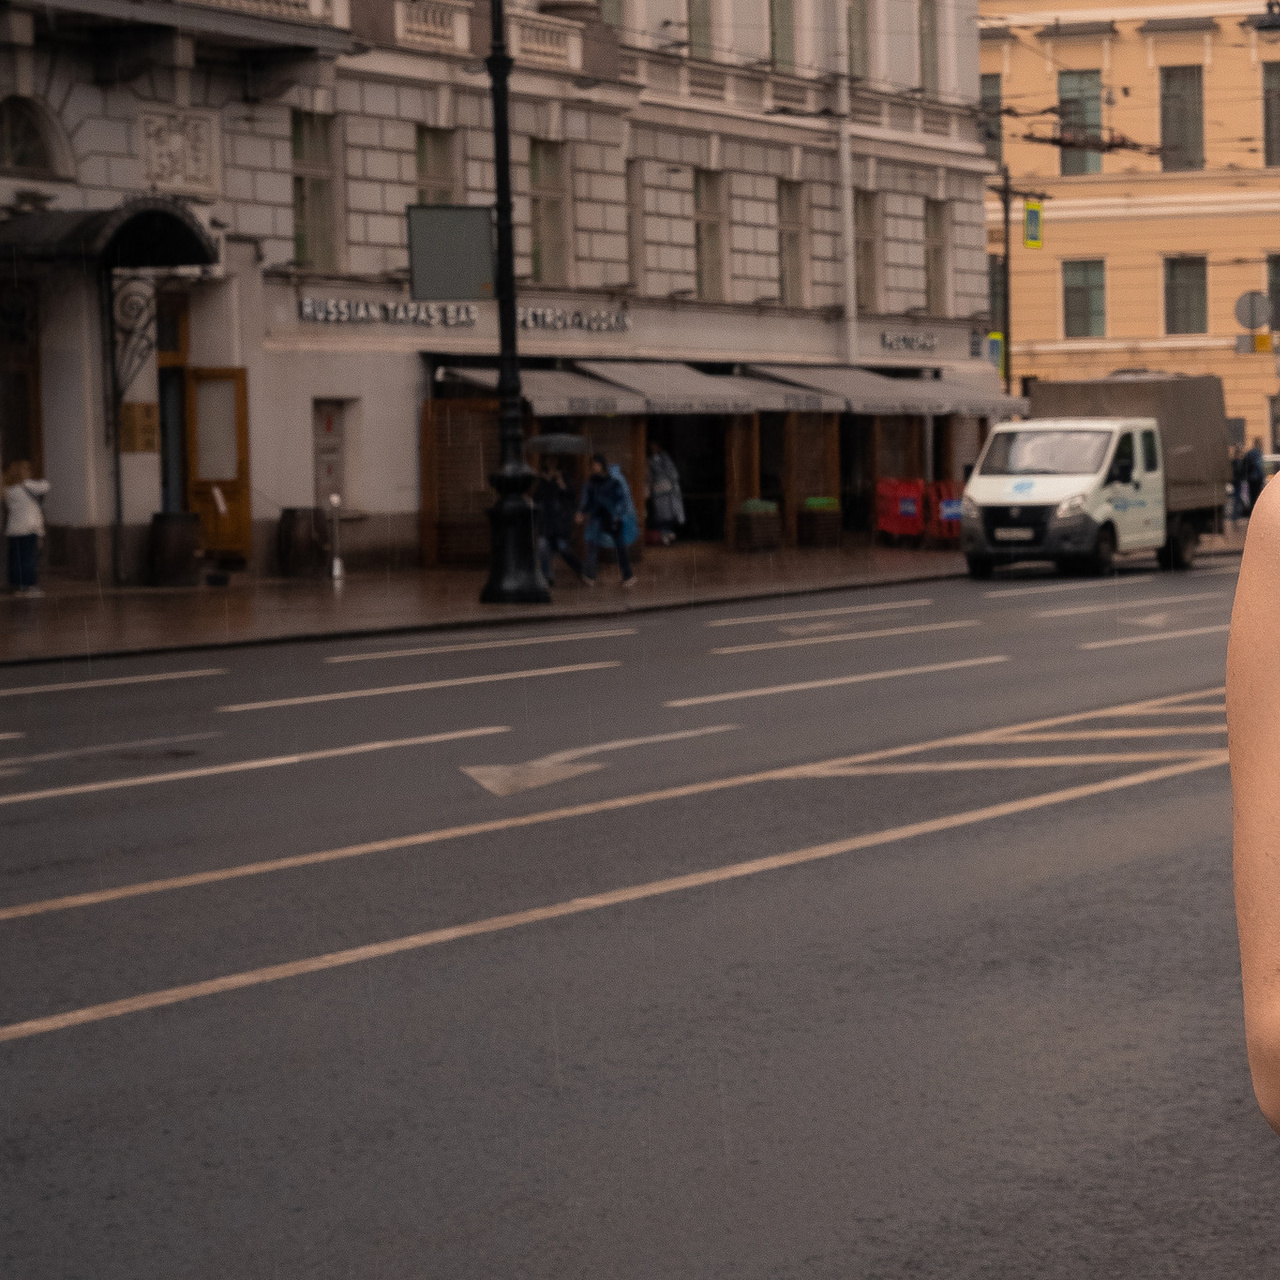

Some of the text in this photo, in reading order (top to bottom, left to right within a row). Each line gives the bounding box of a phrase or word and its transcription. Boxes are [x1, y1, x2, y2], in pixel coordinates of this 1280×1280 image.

[301, 297, 480, 326] RUSSIAN TAPAS BAR
